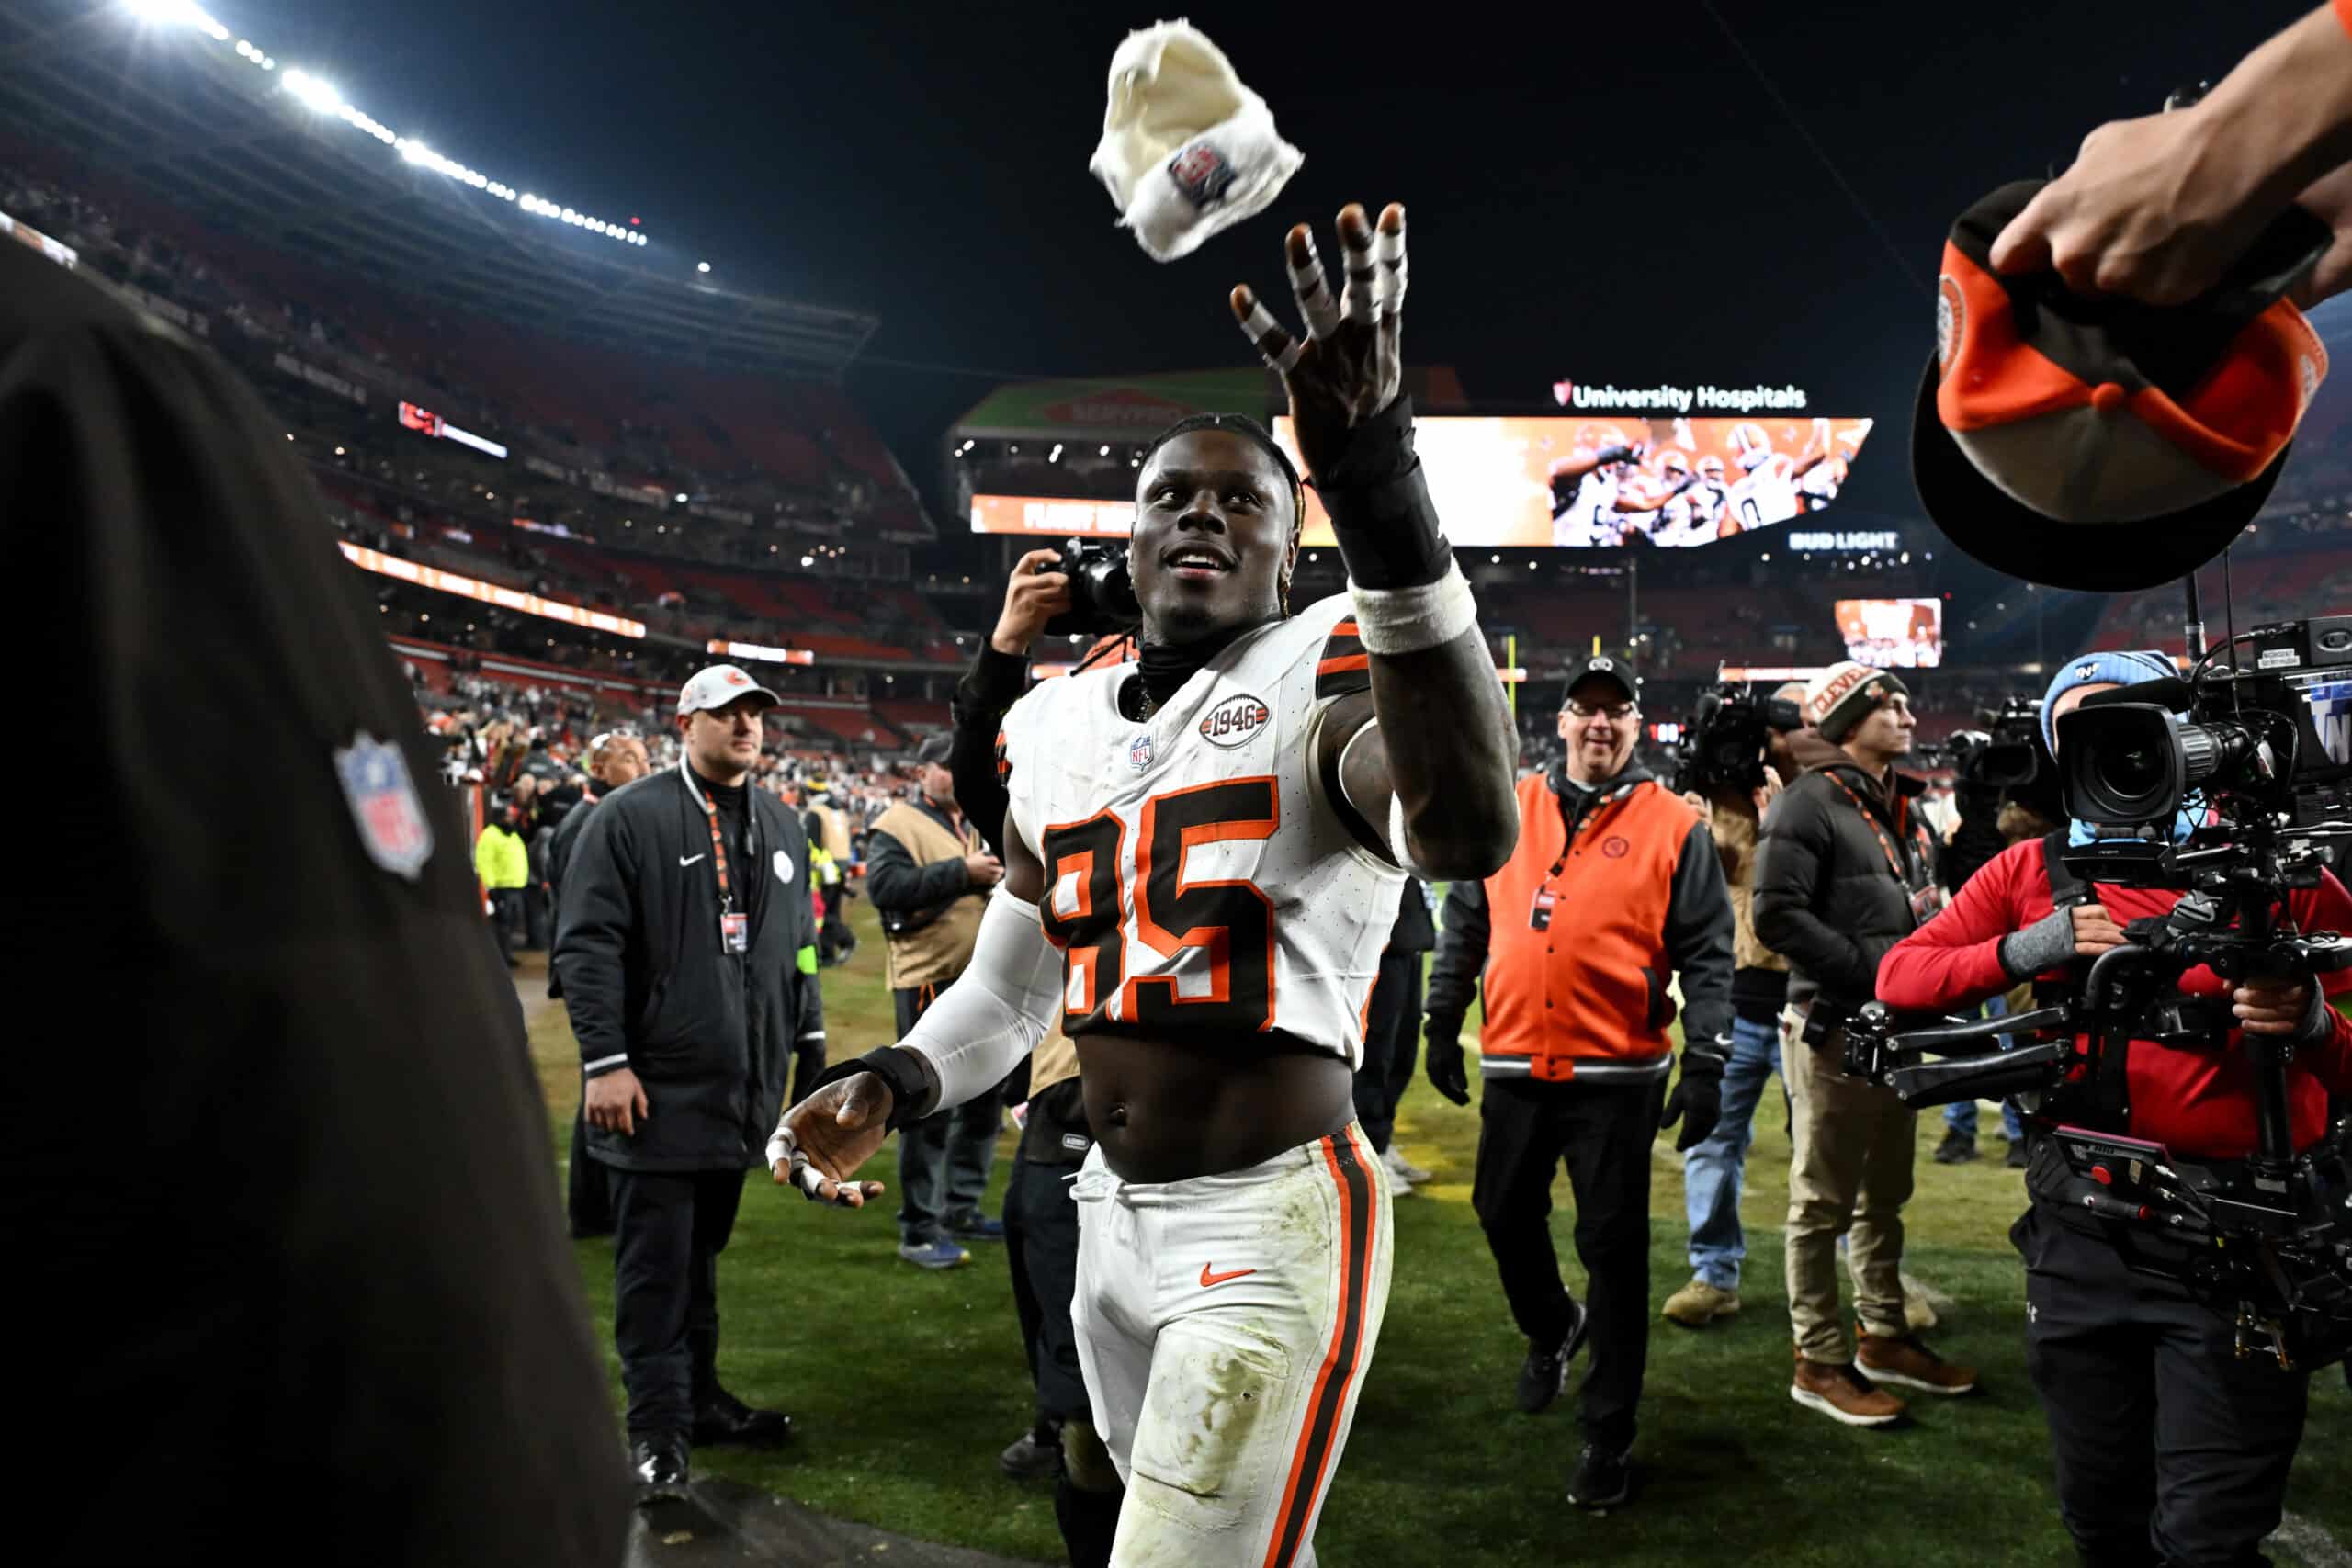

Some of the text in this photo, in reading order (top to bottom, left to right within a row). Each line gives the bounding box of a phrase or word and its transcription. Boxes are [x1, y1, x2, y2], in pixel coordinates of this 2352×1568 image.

[1572, 384, 1807, 412] University Hospitals
[1788, 532, 1899, 550] BUD LIGHT
[1212, 704, 1257, 737] 1946
[1131, 748, 1150, 763] NFL
[1038, 775, 1280, 1037] 85
